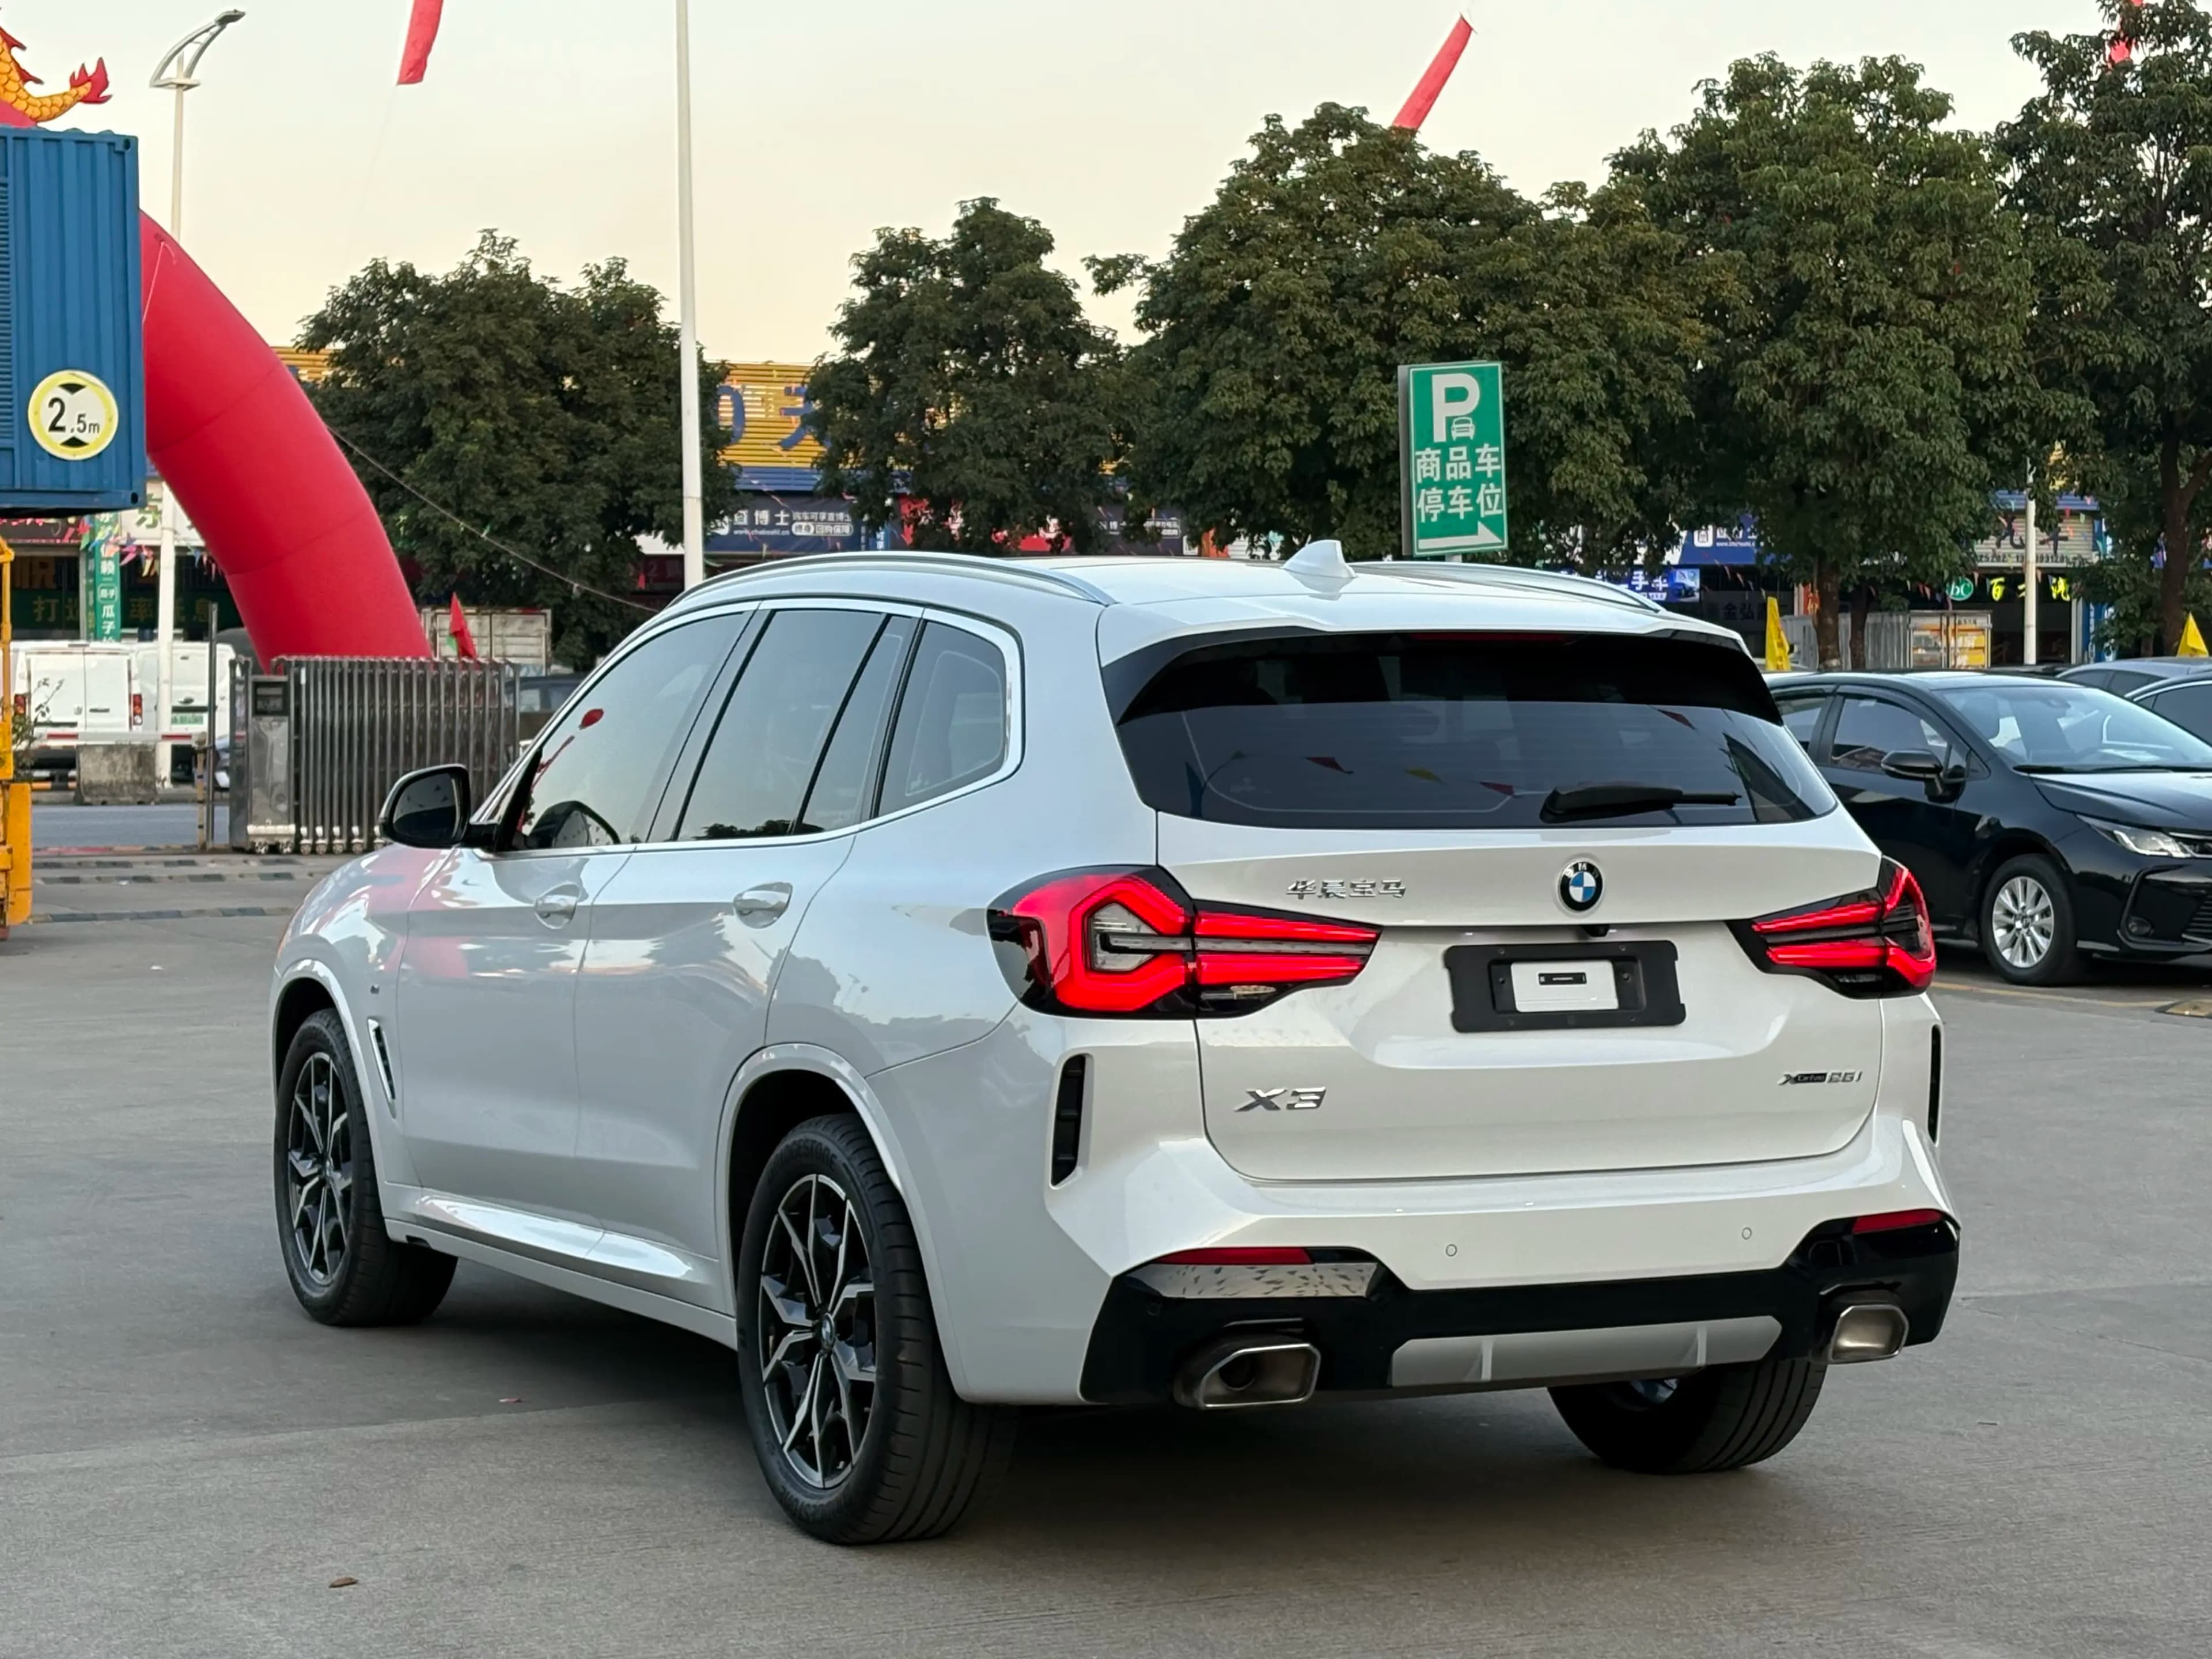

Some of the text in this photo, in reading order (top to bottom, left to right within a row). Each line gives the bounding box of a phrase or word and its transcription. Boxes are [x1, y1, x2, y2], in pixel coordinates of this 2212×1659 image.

[48, 397, 100, 434] 2.5m
[1432, 373, 1480, 442] P
[1415, 443, 1501, 483] 商品车
[1417, 483, 1503, 523] 停车位
[1286, 878, 1406, 900] 华晨宝马
[1234, 1086, 1327, 1112] X3
